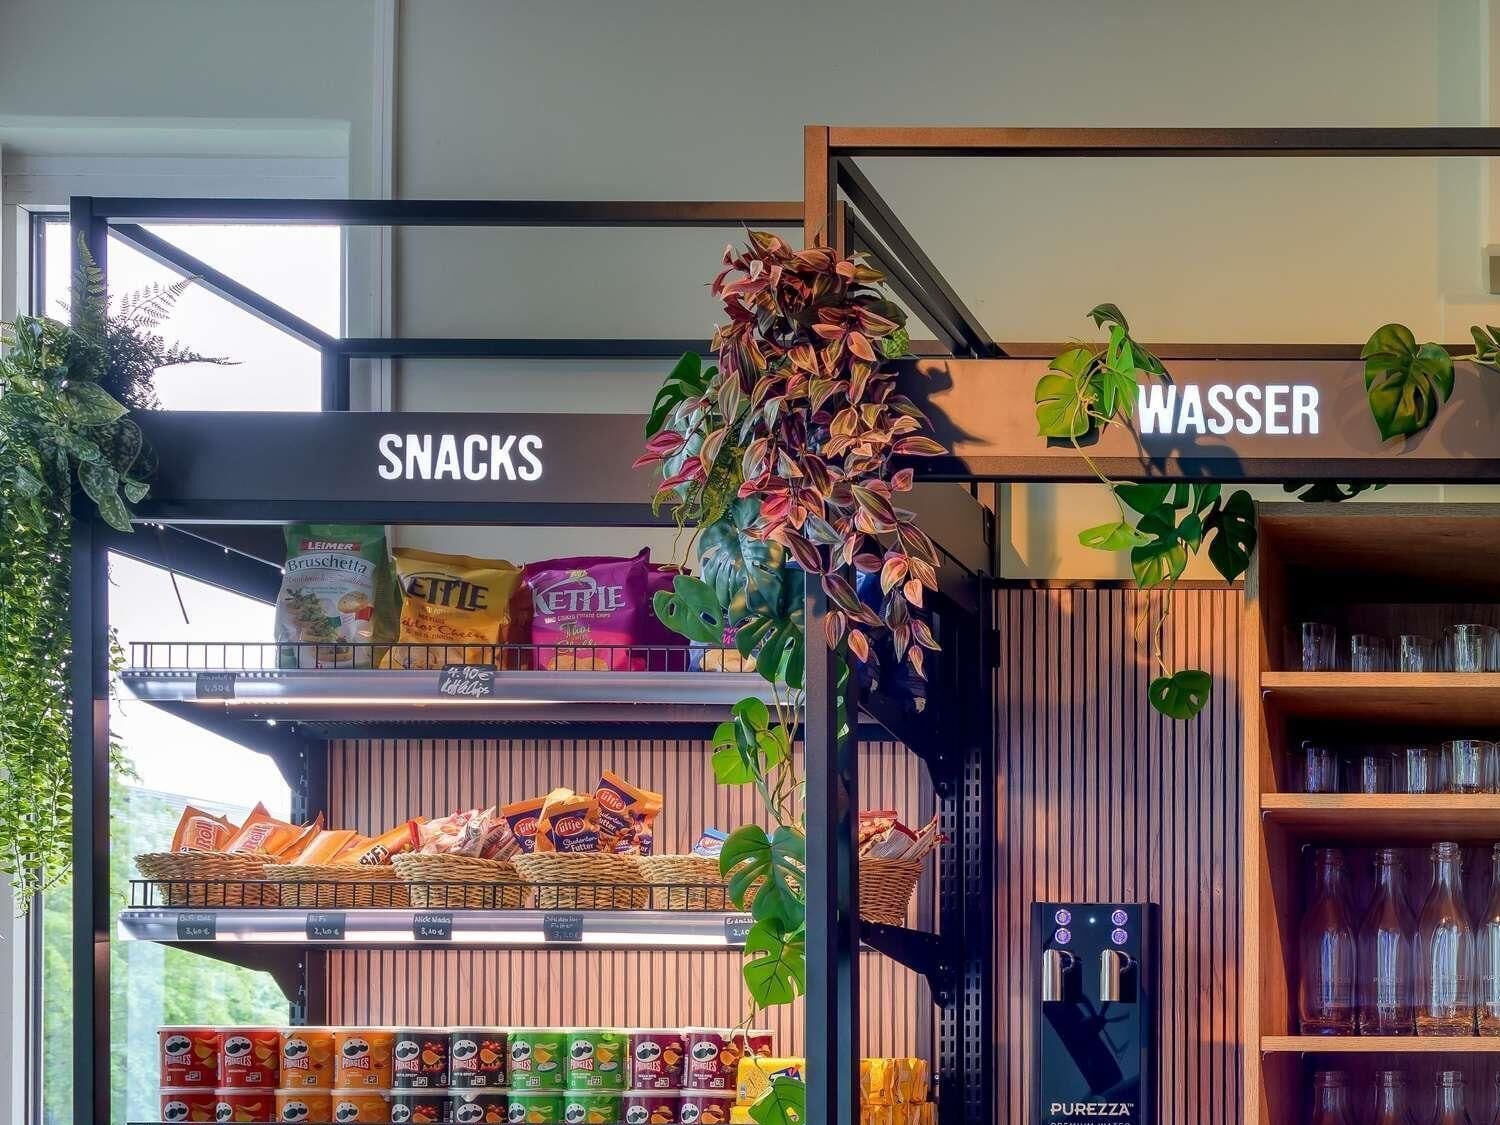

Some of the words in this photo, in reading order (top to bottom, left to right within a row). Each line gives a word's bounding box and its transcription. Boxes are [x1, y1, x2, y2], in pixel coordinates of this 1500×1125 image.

[1138, 384, 1320, 434] WASSER
[378, 433, 543, 482] SNACKS
[307, 541, 354, 550] LEIMER
[287, 554, 368, 575] Bruschetta
[532, 578, 626, 617] KETTLE
[601, 791, 623, 809] ültje
[559, 819, 583, 833] ültje
[283, 1057, 309, 1070] PRINGLES
[342, 1056, 370, 1070] PRINGLES
[395, 1059, 419, 1071] PRINGLES
[453, 1059, 477, 1071] PRINGLES
[570, 1058, 593, 1071] PRINGLES
[635, 1060, 661, 1073] PRINGLES
[692, 1060, 718, 1073] PRINGLES
